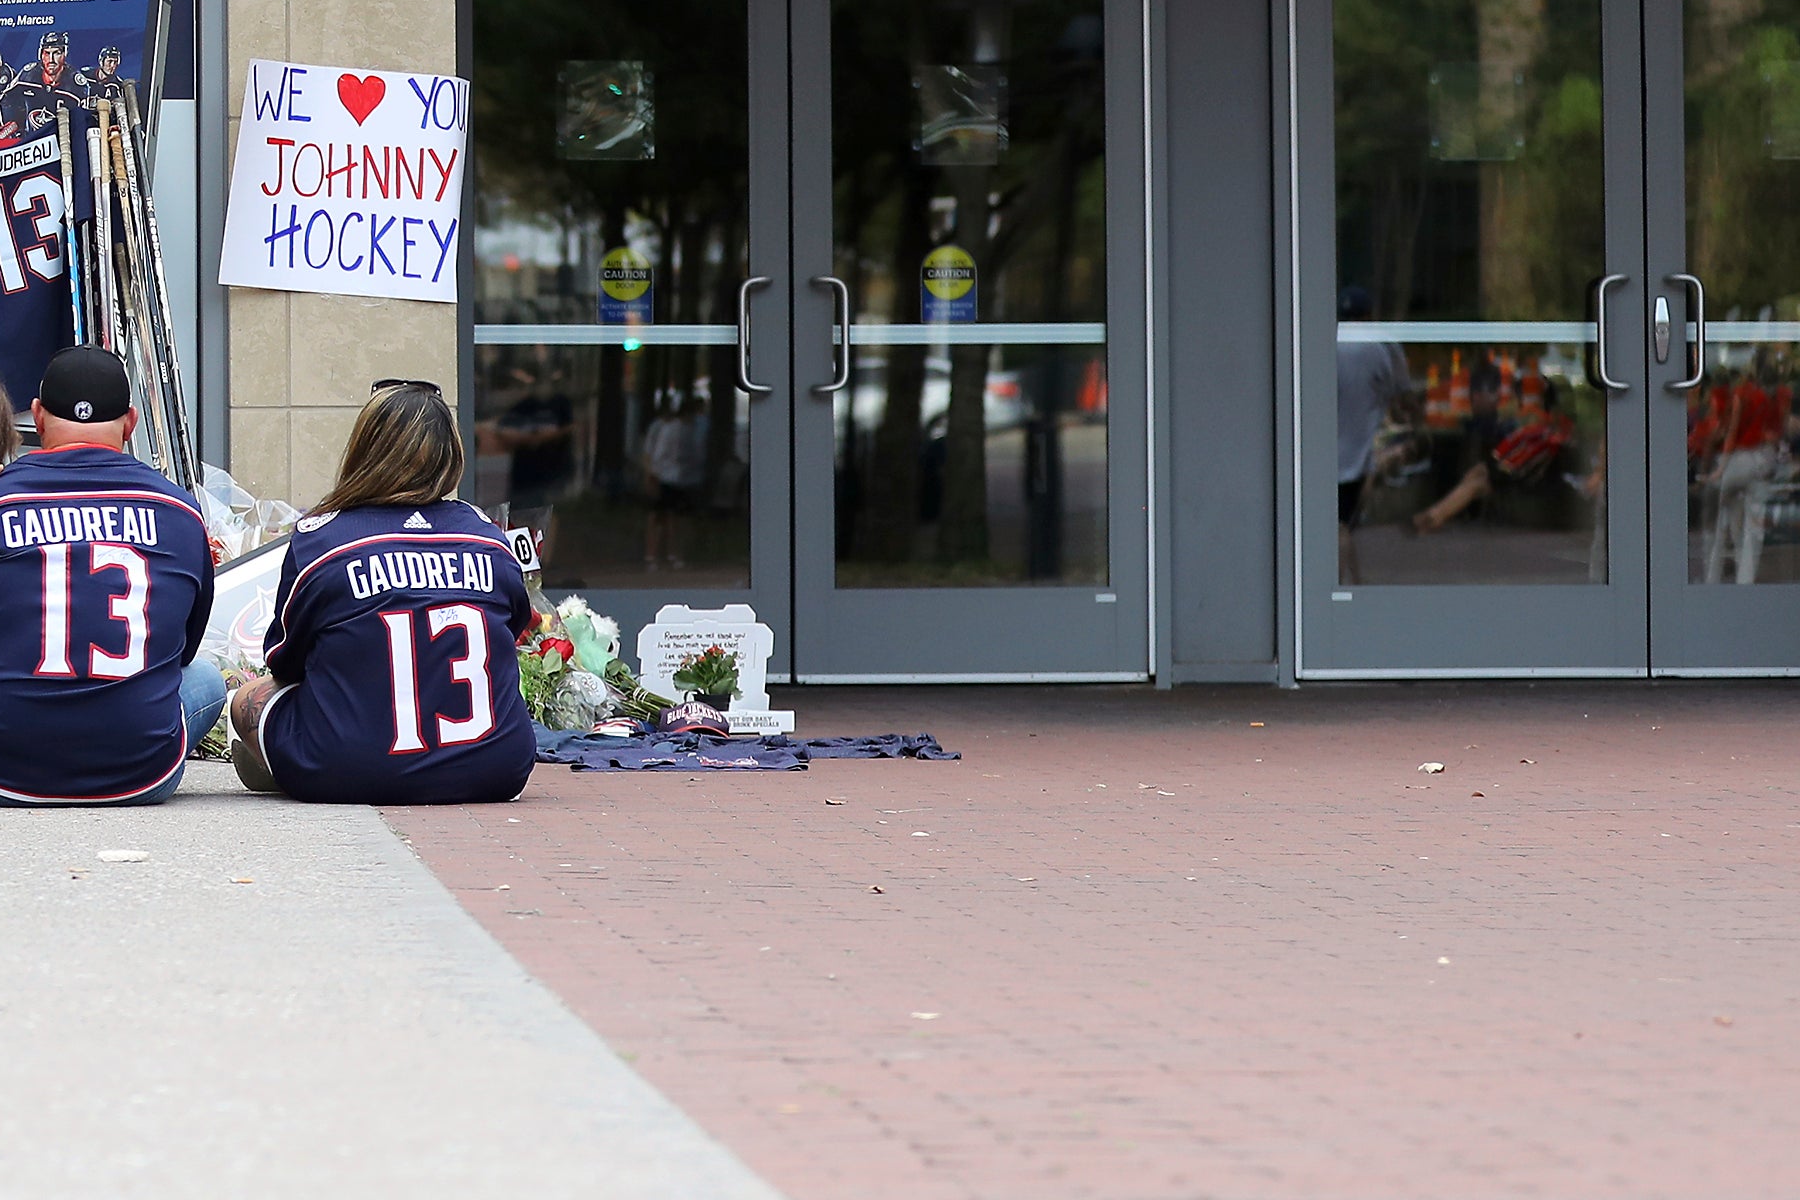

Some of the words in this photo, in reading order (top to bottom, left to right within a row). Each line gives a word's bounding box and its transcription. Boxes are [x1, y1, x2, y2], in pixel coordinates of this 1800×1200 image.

[17, 14, 54, 26] Marcus
[253, 64, 312, 122] WE
[407, 76, 469, 133] YOU
[260, 137, 458, 202] JOHNNY
[263, 203, 458, 284] HOCKEY
[603, 269, 647, 279] CAUTION
[927, 268, 970, 278] CAUTION
[0, 506, 158, 549] GAUDREAU
[403, 521, 433, 530] adidas
[517, 541, 532, 561] 13
[345, 551, 495, 601] GAUDREAU
[33, 541, 153, 681] 13
[378, 601, 497, 756] 13
[666, 705, 688, 725] BLUE
[688, 702, 724, 725] JACKETS
